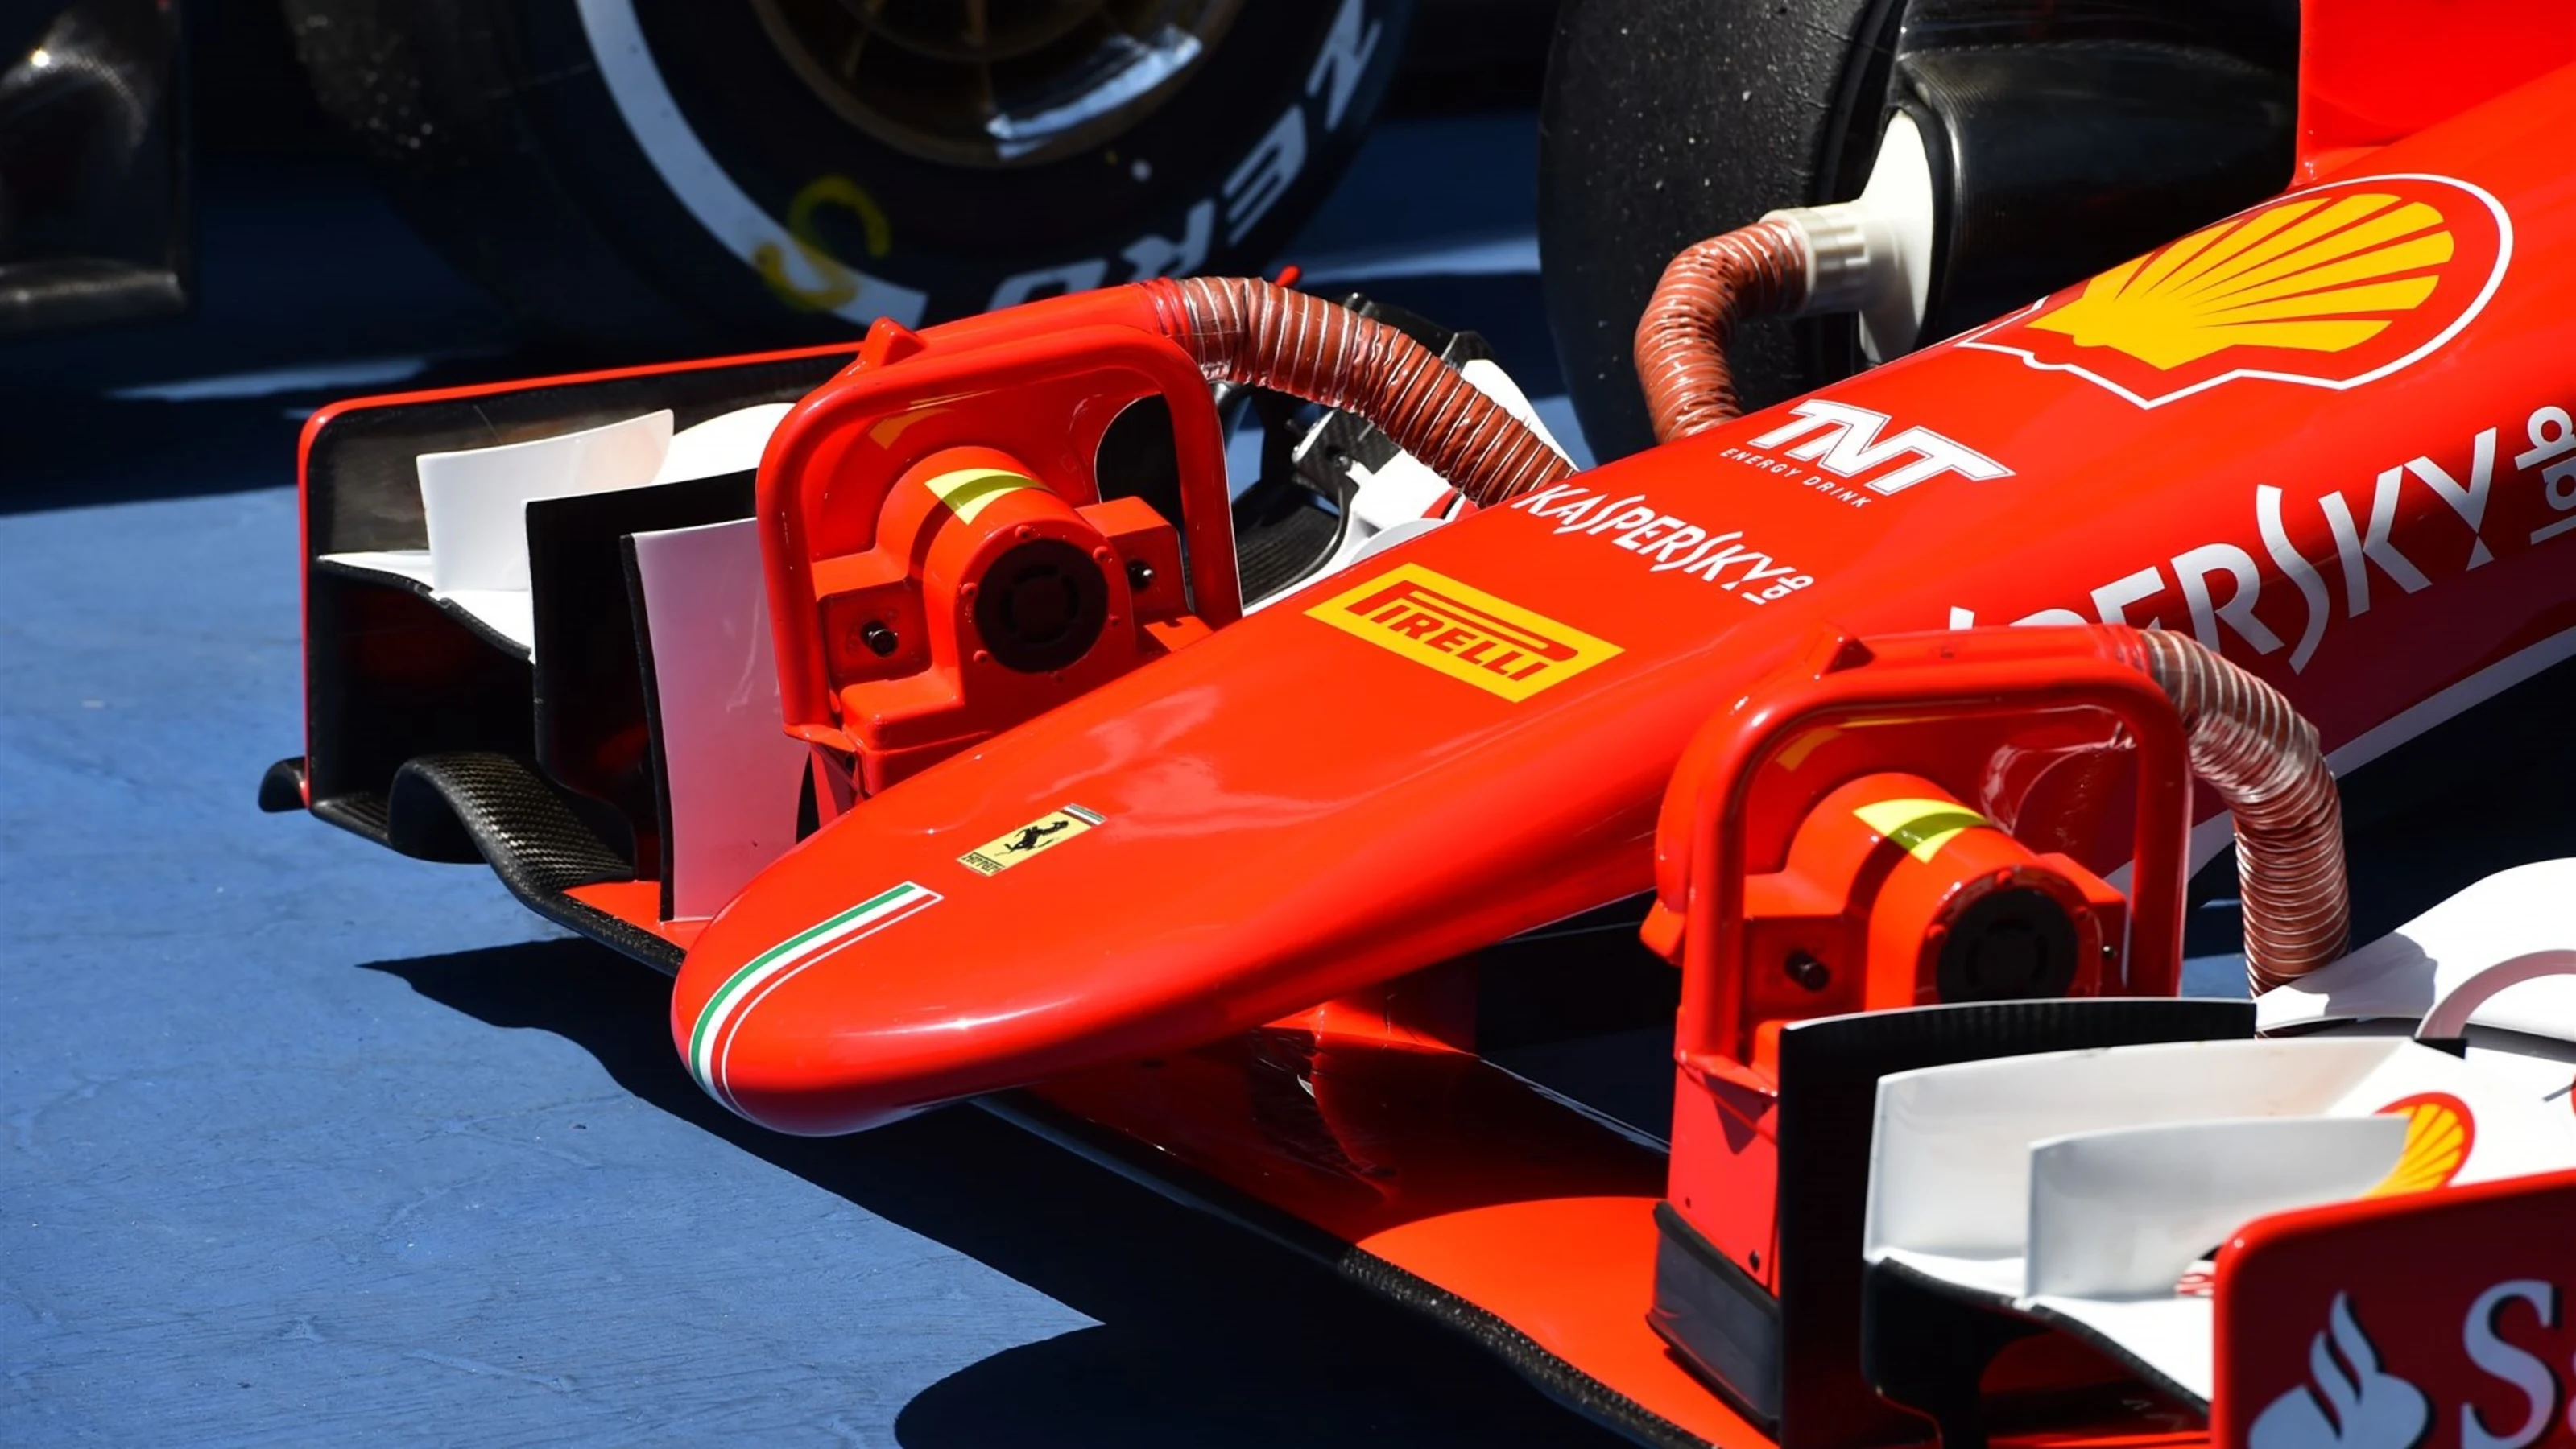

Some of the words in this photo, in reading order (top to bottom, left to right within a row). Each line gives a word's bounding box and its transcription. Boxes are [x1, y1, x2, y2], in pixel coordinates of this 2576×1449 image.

[1720, 448, 1802, 479] ENERGY
[1802, 475, 1872, 508] DRINK
[1747, 399, 2016, 497] TNT
[1510, 483, 1797, 592] KASPERSKY
[1343, 580, 1579, 682] PIRELLI
[2461, 1278, 2576, 1449] S
